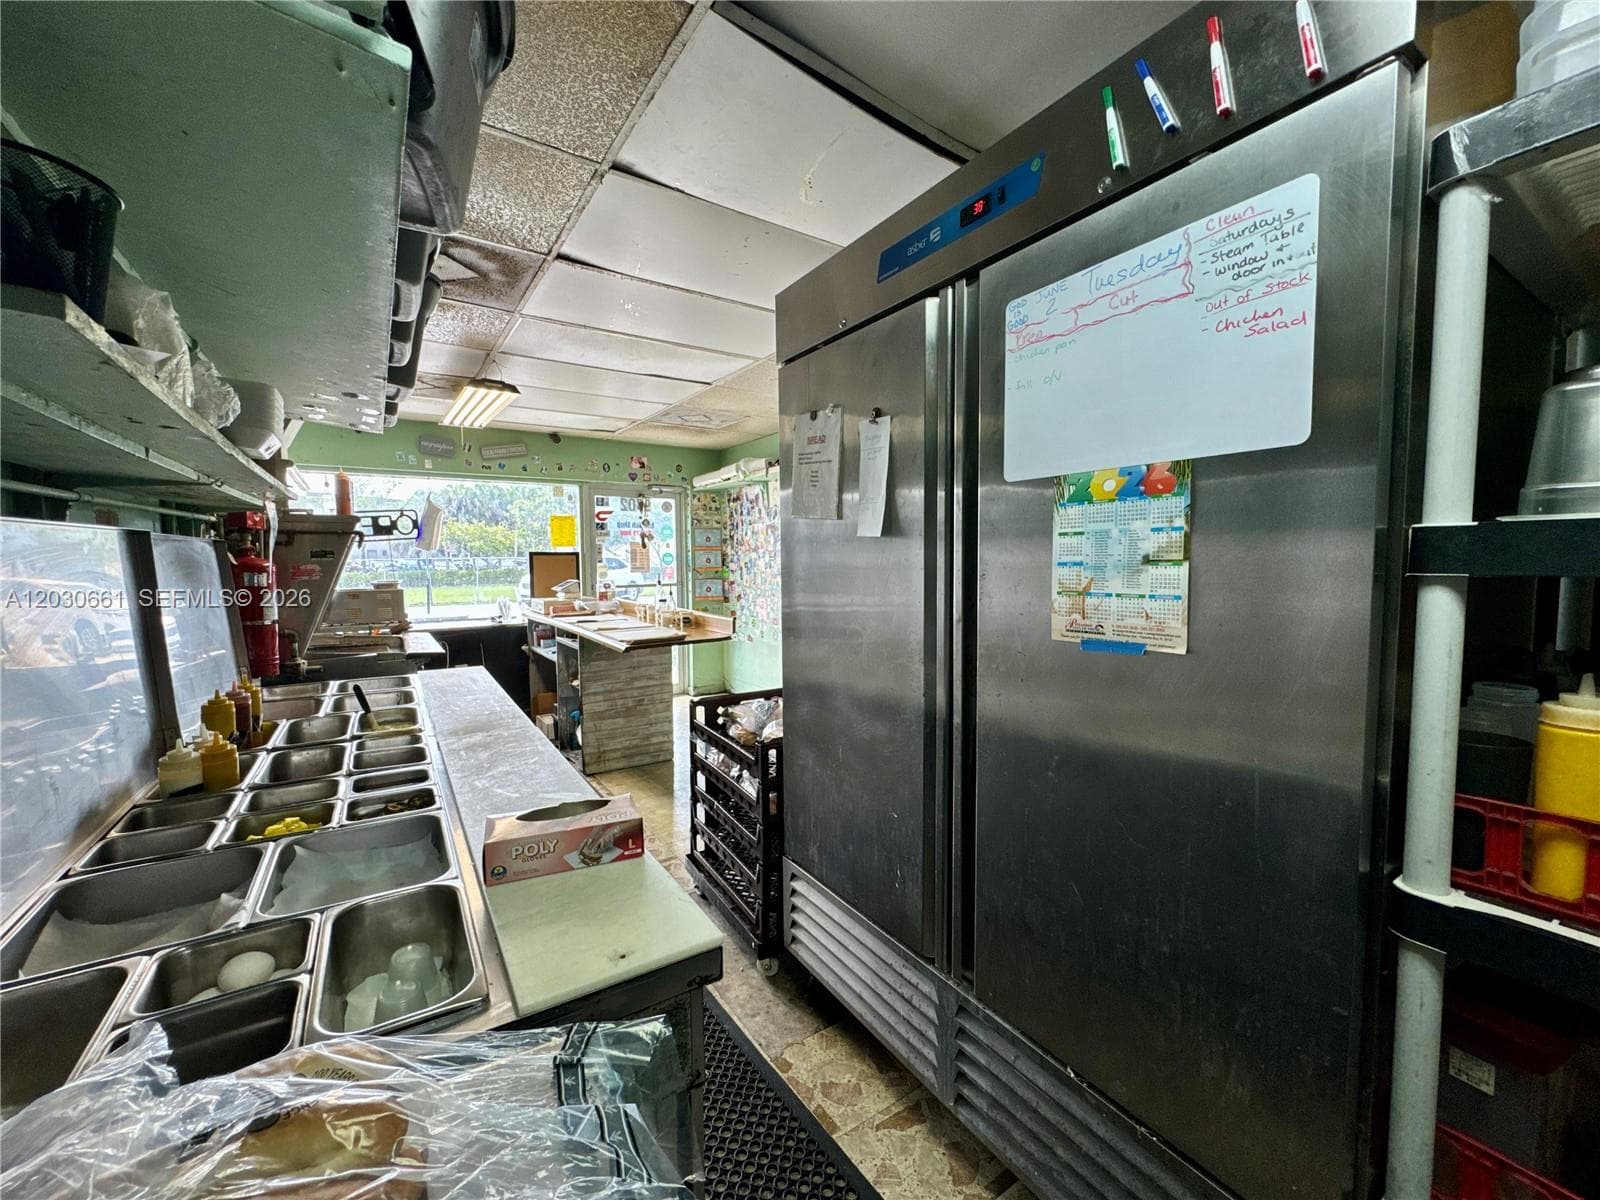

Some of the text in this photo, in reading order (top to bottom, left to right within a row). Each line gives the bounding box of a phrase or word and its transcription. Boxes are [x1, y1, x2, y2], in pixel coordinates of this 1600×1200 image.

[1205, 206, 1255, 231] Clean
[1211, 222, 1304, 264] Steam Table
[1081, 243, 1182, 297] Tuesday
[1232, 264, 1266, 280] door
[1037, 280, 1069, 304] JUNE
[1108, 290, 1139, 310] Cut
[1237, 288, 1252, 304] of
[1262, 272, 1312, 294] Stock
[1215, 307, 1284, 333] Chicken
[1244, 311, 1307, 337] Salad
[1066, 463, 1177, 503] 2026
[511, 839, 560, 861] POLY
